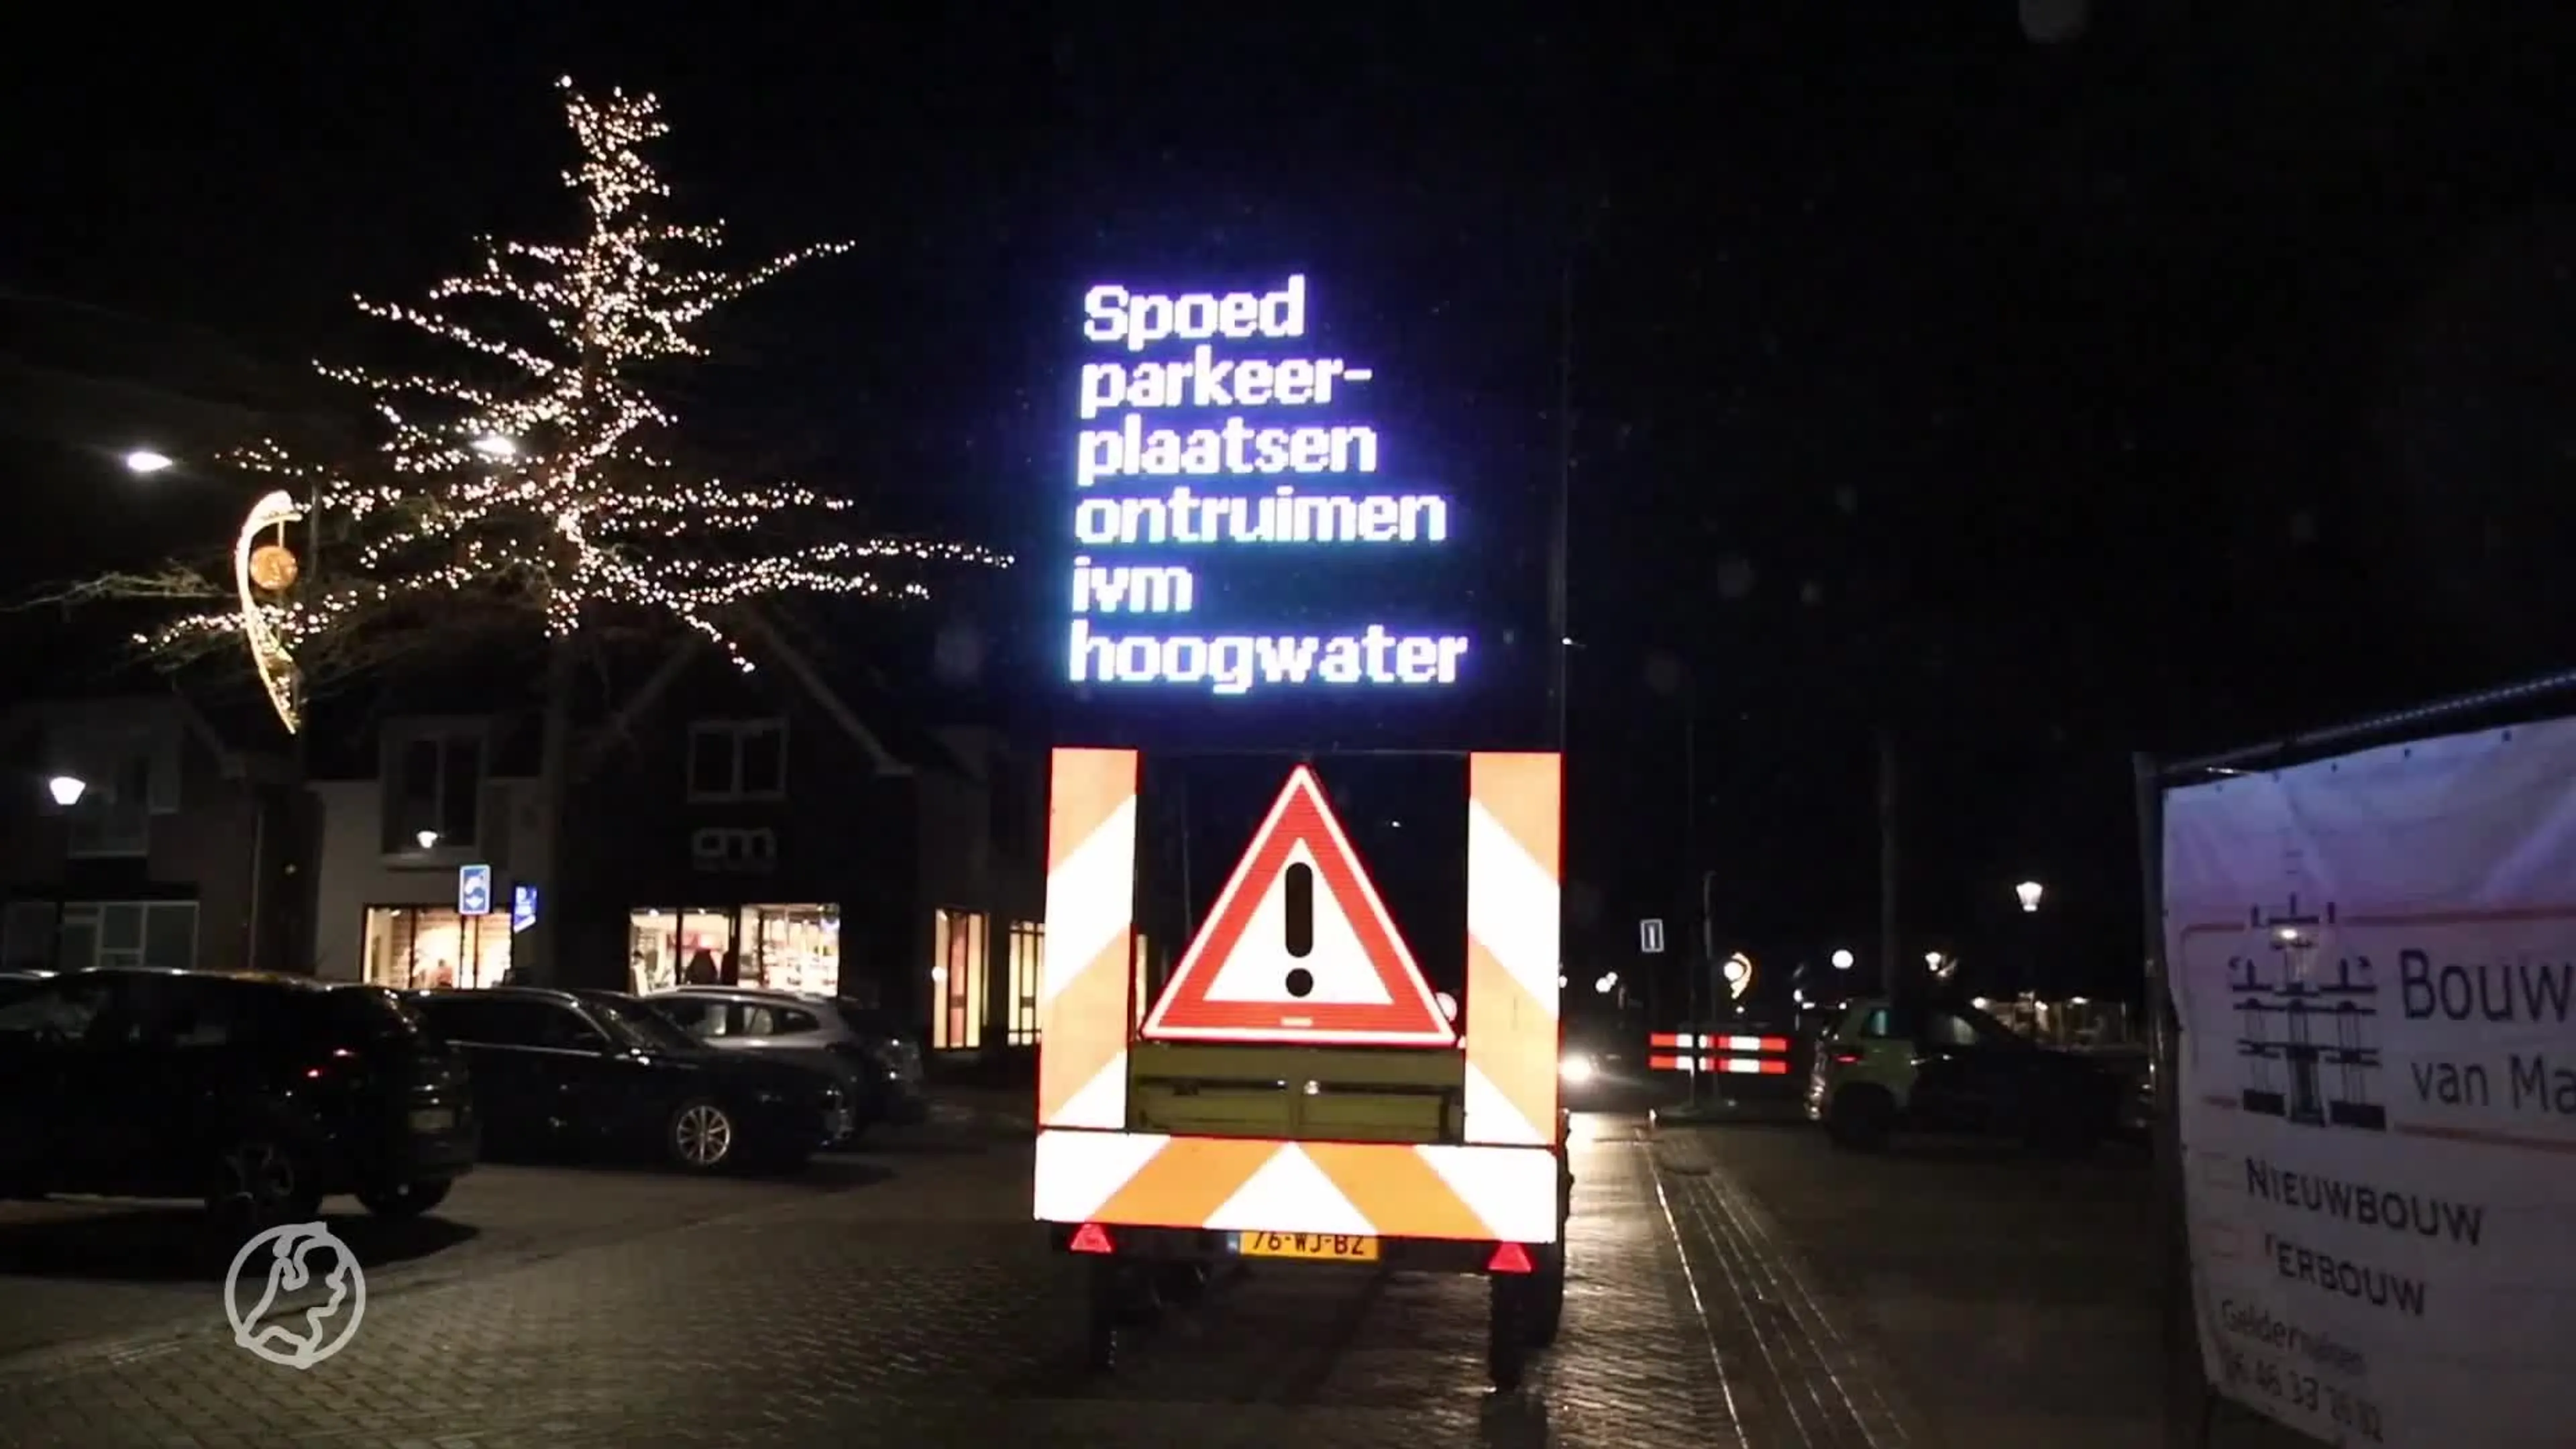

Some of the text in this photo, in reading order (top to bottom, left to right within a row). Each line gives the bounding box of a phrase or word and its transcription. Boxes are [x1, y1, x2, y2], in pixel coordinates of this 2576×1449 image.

[1083, 274, 1305, 351] Spoed
[1080, 344, 1373, 419] parkeer-
[1077, 413, 1378, 487] plaatsen
[1075, 485, 1447, 544] ontruimen
[1072, 555, 1193, 612] ivm
[1069, 618, 1468, 694] hoogwater
[2400, 948, 2574, 1022] Bouw
[2410, 1053, 2576, 1115] van Ma
[2245, 1155, 2485, 1246] NIEUWBOUW
